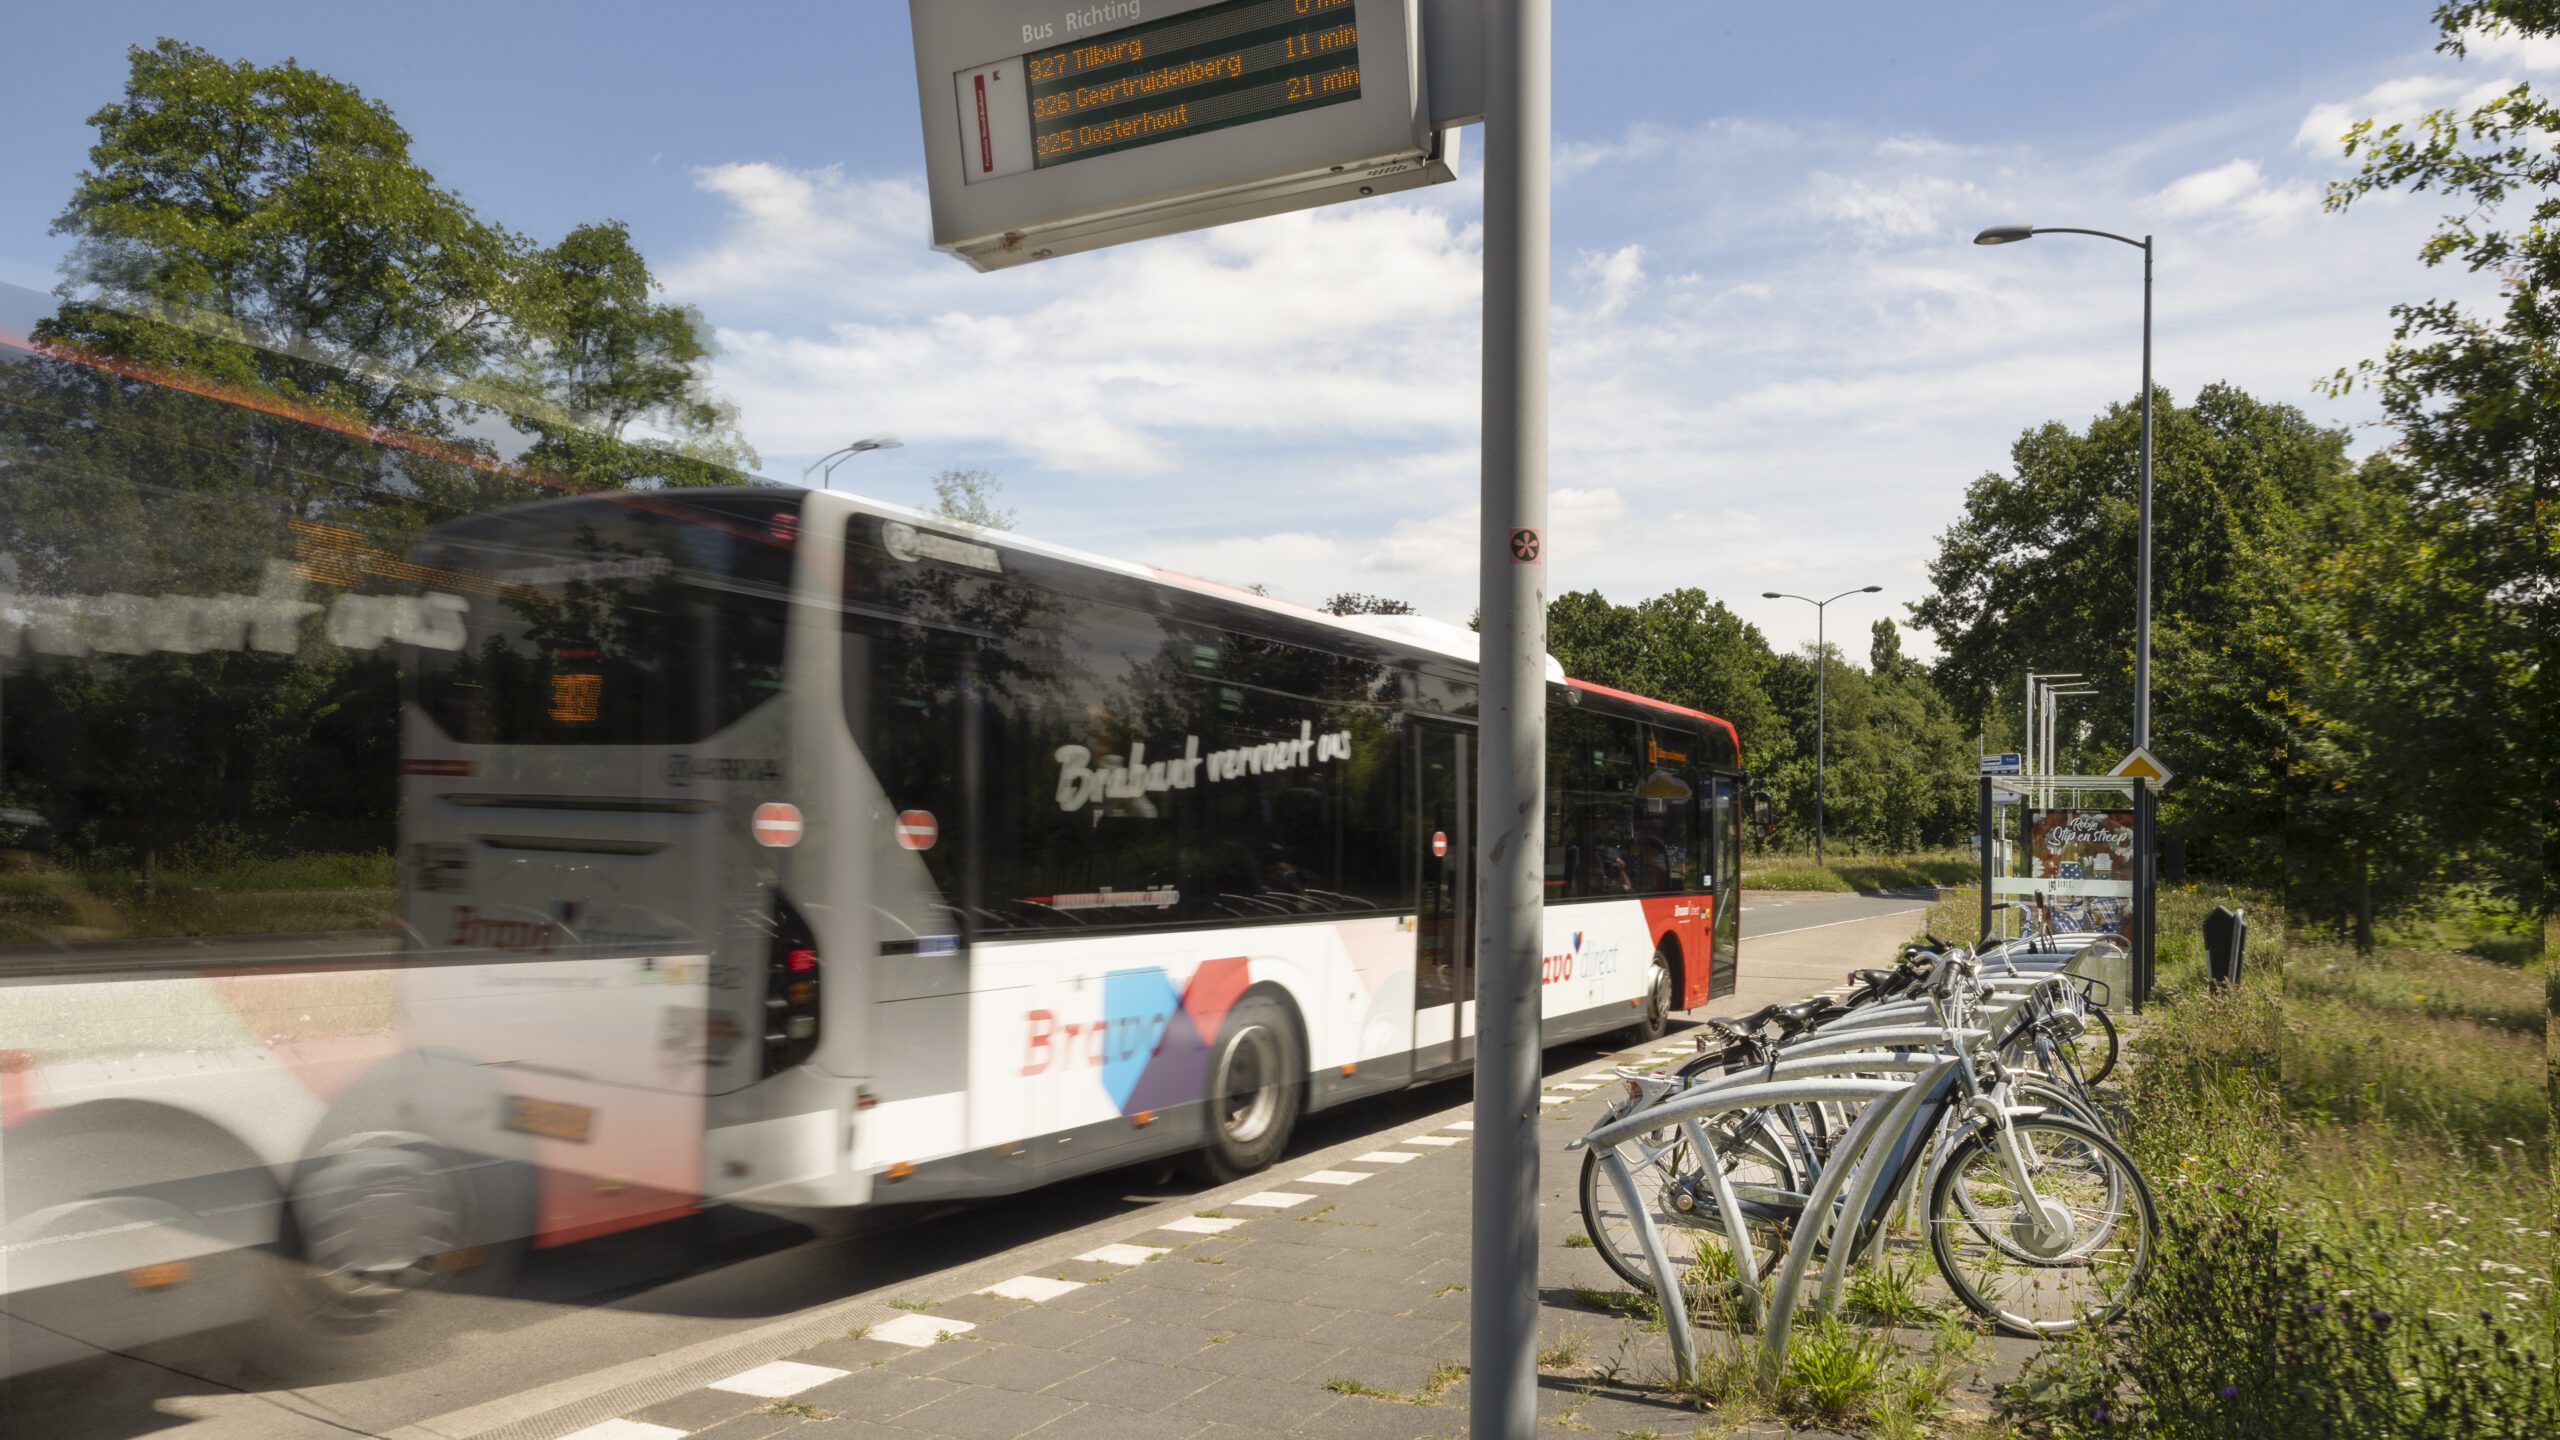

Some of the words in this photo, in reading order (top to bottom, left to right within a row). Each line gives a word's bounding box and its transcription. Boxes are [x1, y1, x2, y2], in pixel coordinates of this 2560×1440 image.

[1022, 23, 1054, 43] Bus
[1066, 0, 1140, 31] Richting
[1029, 53, 1067, 81] 327
[1072, 38, 1141, 69] Tilburg
[1033, 91, 1070, 119] 326
[1075, 55, 1241, 108] Geertruidenberg
[1286, 33, 1310, 58] 11
[1320, 25, 1356, 50] min
[1037, 129, 1073, 155] 325
[1079, 103, 1188, 145] Oosterhout
[1286, 74, 1312, 100] 21
[1323, 66, 1359, 93] min
[2048, 826, 2076, 846] Stip
[2078, 833, 2091, 842] en
[2093, 828, 2128, 846] streep
[1541, 953, 1573, 985] avo
